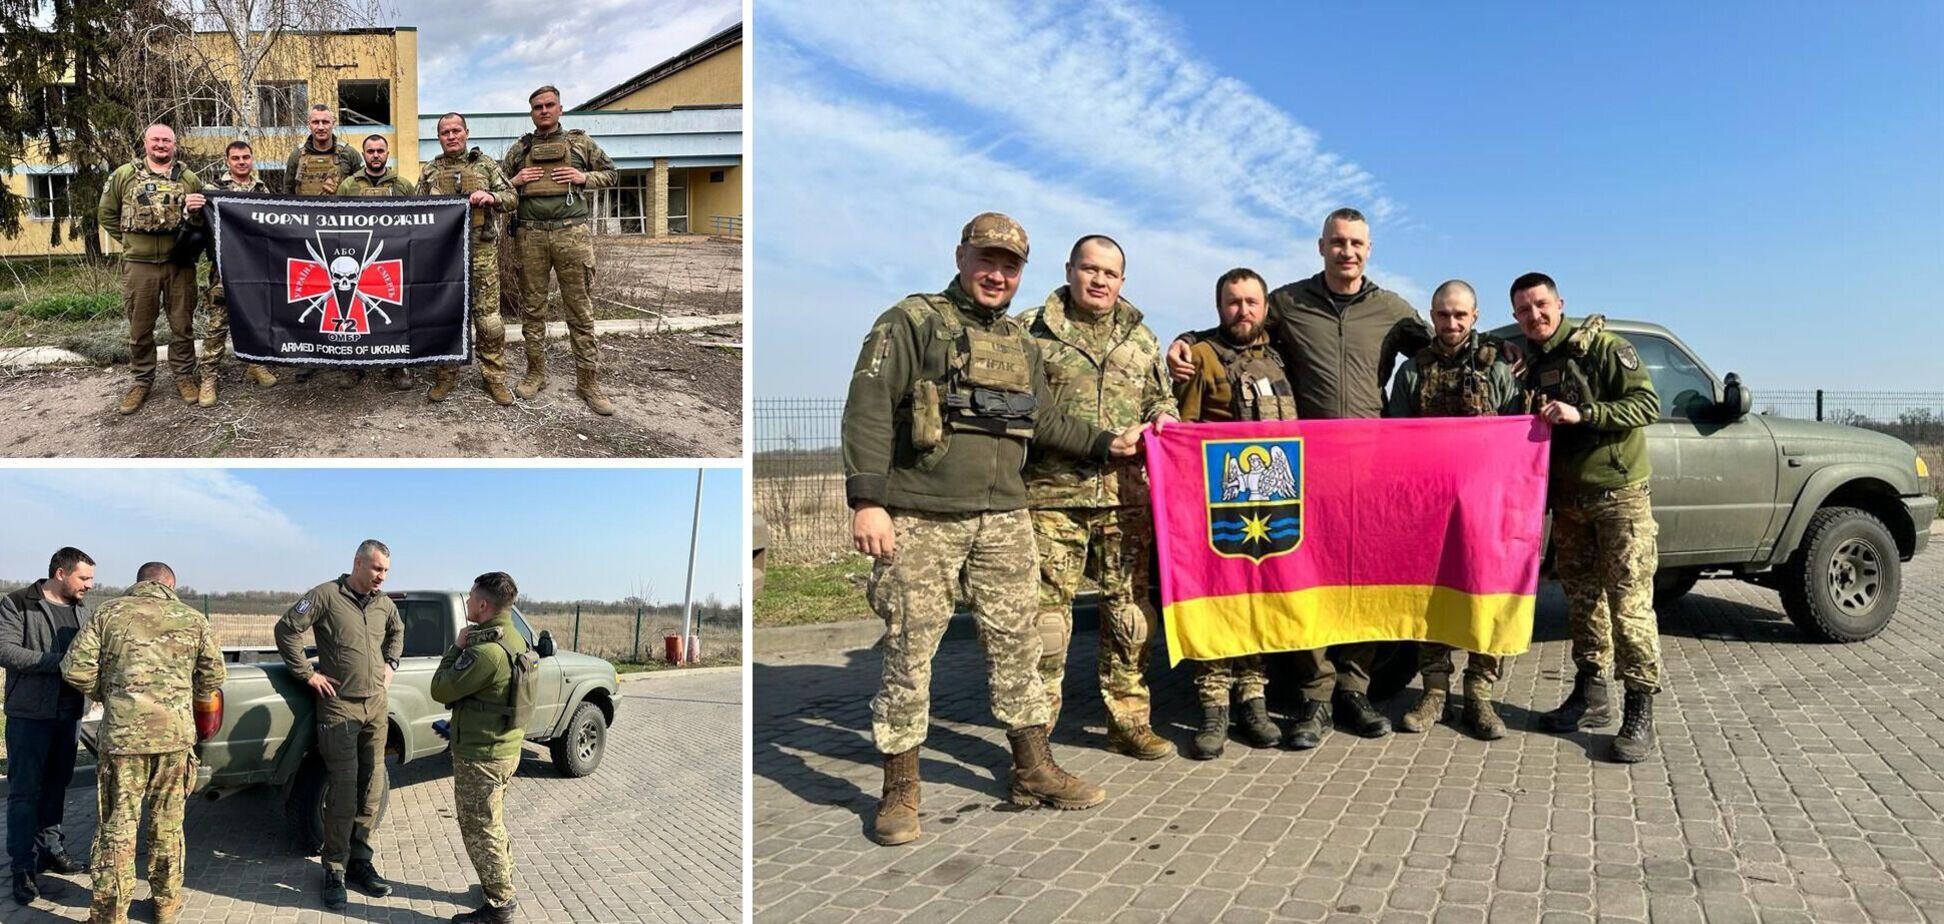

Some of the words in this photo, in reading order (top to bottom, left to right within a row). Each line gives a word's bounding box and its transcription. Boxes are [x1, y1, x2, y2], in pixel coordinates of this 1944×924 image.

[333, 247, 356, 256] АБО
[331, 318, 358, 333] 72
[280, 342, 315, 353] ARMED
[316, 344, 353, 355] FORCES
[355, 345, 369, 354] OF
[370, 344, 411, 355] UKRAINE
